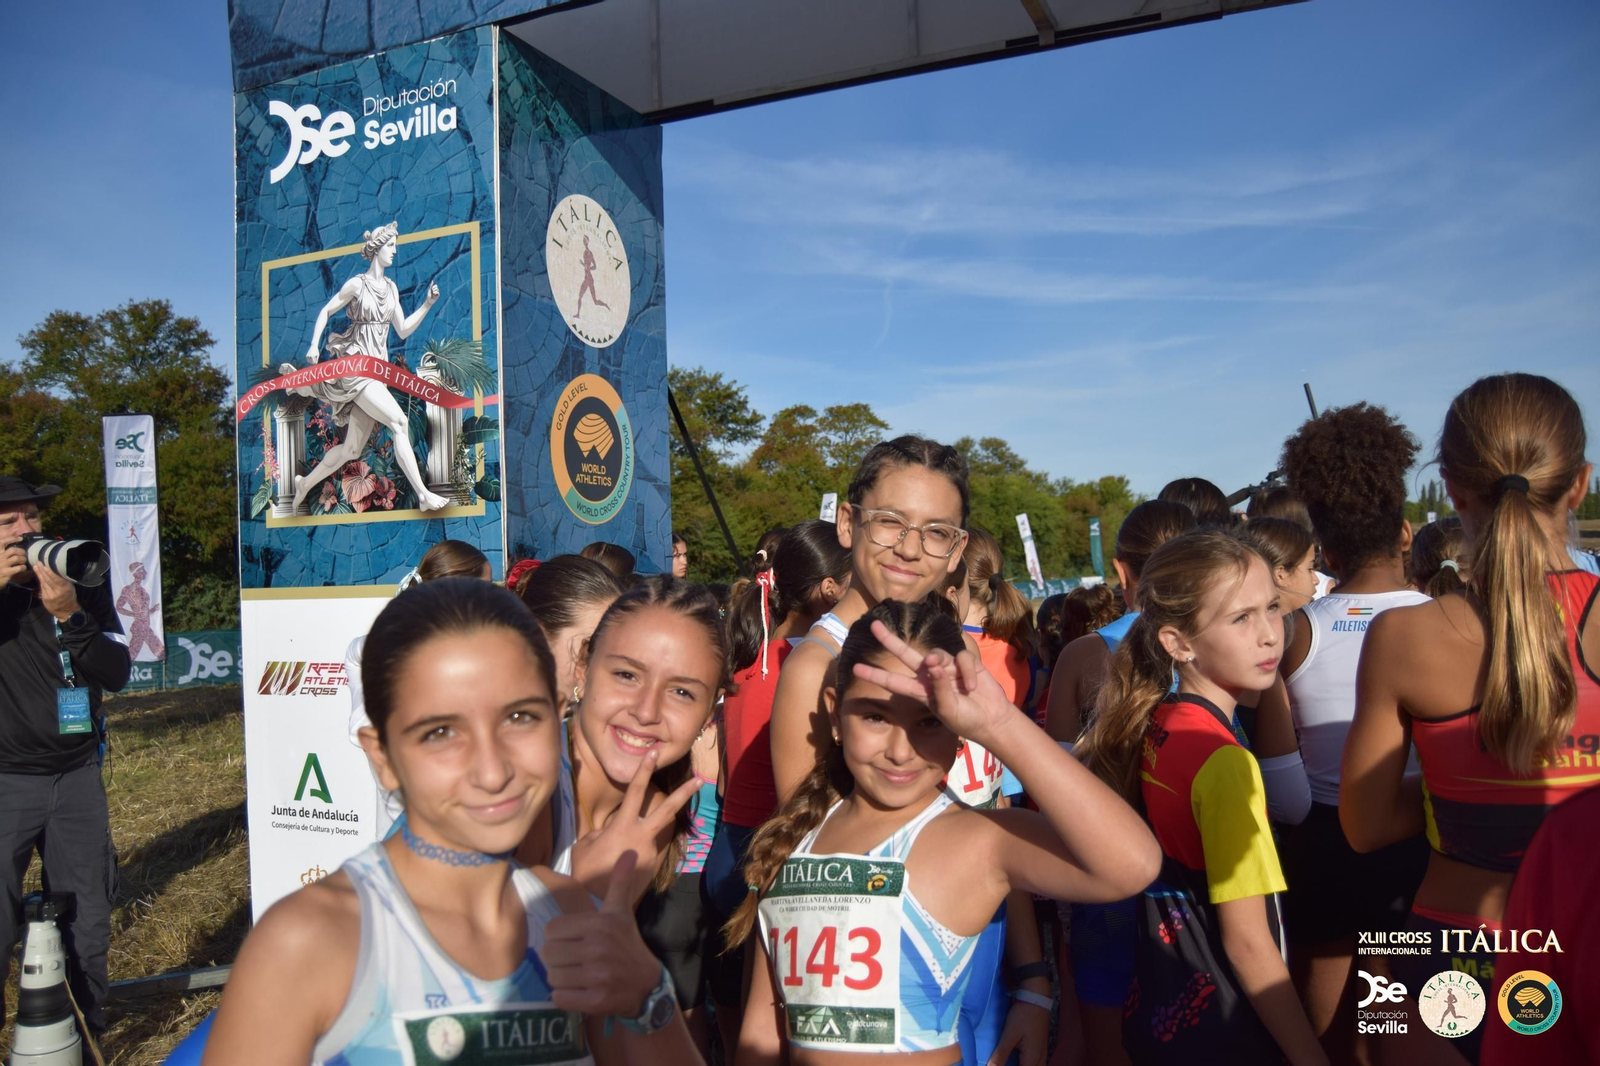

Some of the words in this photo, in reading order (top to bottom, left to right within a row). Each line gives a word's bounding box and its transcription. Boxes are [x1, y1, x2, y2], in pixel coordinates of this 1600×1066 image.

[363, 77, 457, 118] Diputación
[364, 103, 457, 150] Sevilla
[552, 198, 624, 271] ITÁLICA
[240, 379, 277, 414] CROSS
[281, 359, 370, 388] INTERNACIONAL
[373, 361, 392, 380] DE
[395, 372, 440, 403] ITÁLICA
[556, 400, 569, 431] GOLD
[568, 382, 588, 402] LEVEL
[622, 423, 631, 450] TOUR
[575, 473, 612, 487] ATHLETICS
[581, 463, 607, 475] WORLD
[617, 454, 631, 498] COUNTRY
[576, 500, 599, 517] WORLD
[599, 496, 619, 516] CROSS
[300, 687, 338, 697] CROSS
[271, 805, 297, 817] Junta
[299, 807, 310, 818] de
[312, 808, 359, 822] Andalucía
[271, 821, 300, 831] Consejería
[309, 824, 330, 833] Cultura
[335, 827, 359, 836] Deporte
[782, 859, 854, 883] ITÁLICA
[792, 896, 832, 904] AVELLANEDA
[834, 896, 871, 905] LORENZO
[481, 1013, 574, 1048] ITÁLICA
